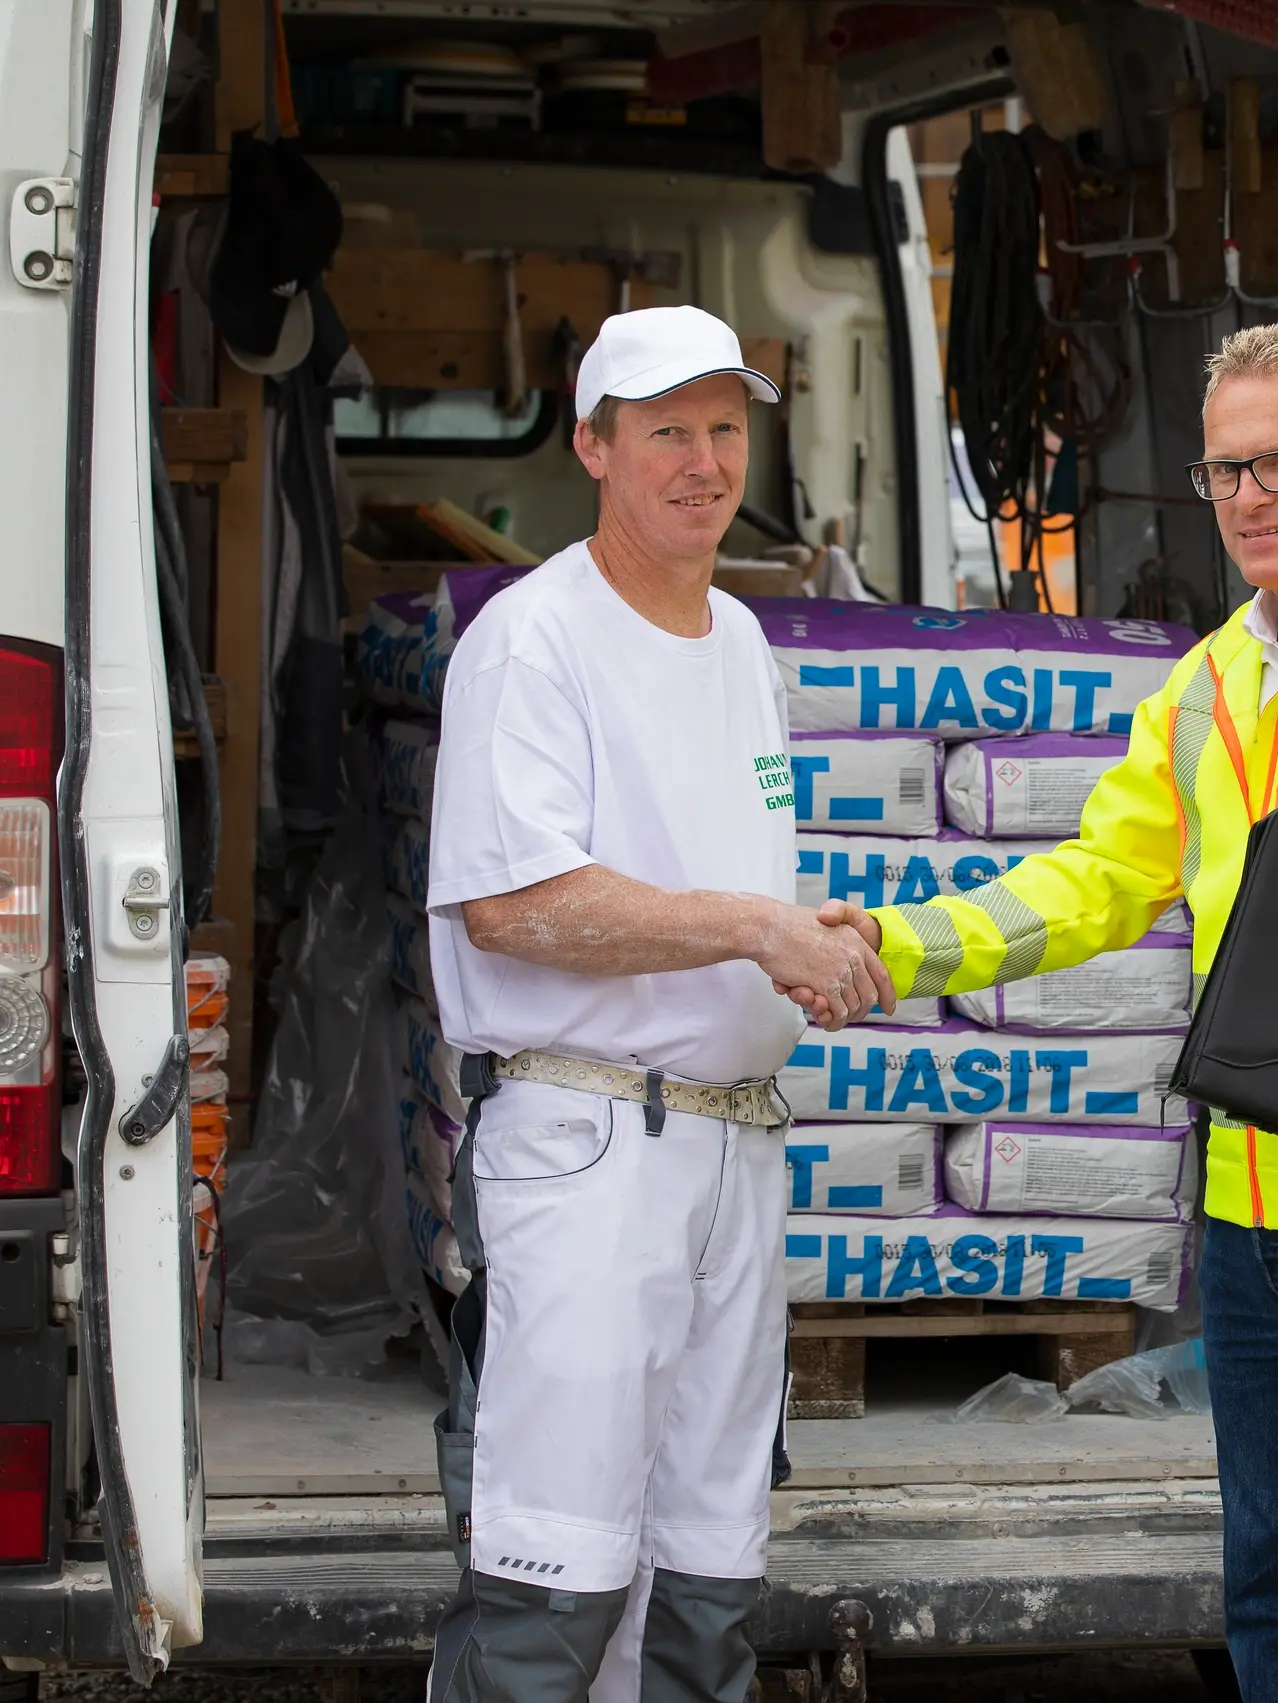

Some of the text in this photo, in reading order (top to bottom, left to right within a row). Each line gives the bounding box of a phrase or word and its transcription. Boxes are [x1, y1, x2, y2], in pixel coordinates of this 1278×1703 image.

[860, 665, 1112, 731] HASIT
[759, 771, 790, 790] LERCH
[765, 793, 794, 810] GMB
[829, 852, 1025, 908] HAS
[829, 1046, 1088, 1114] HASIT
[827, 1234, 1083, 1297] HASIT
